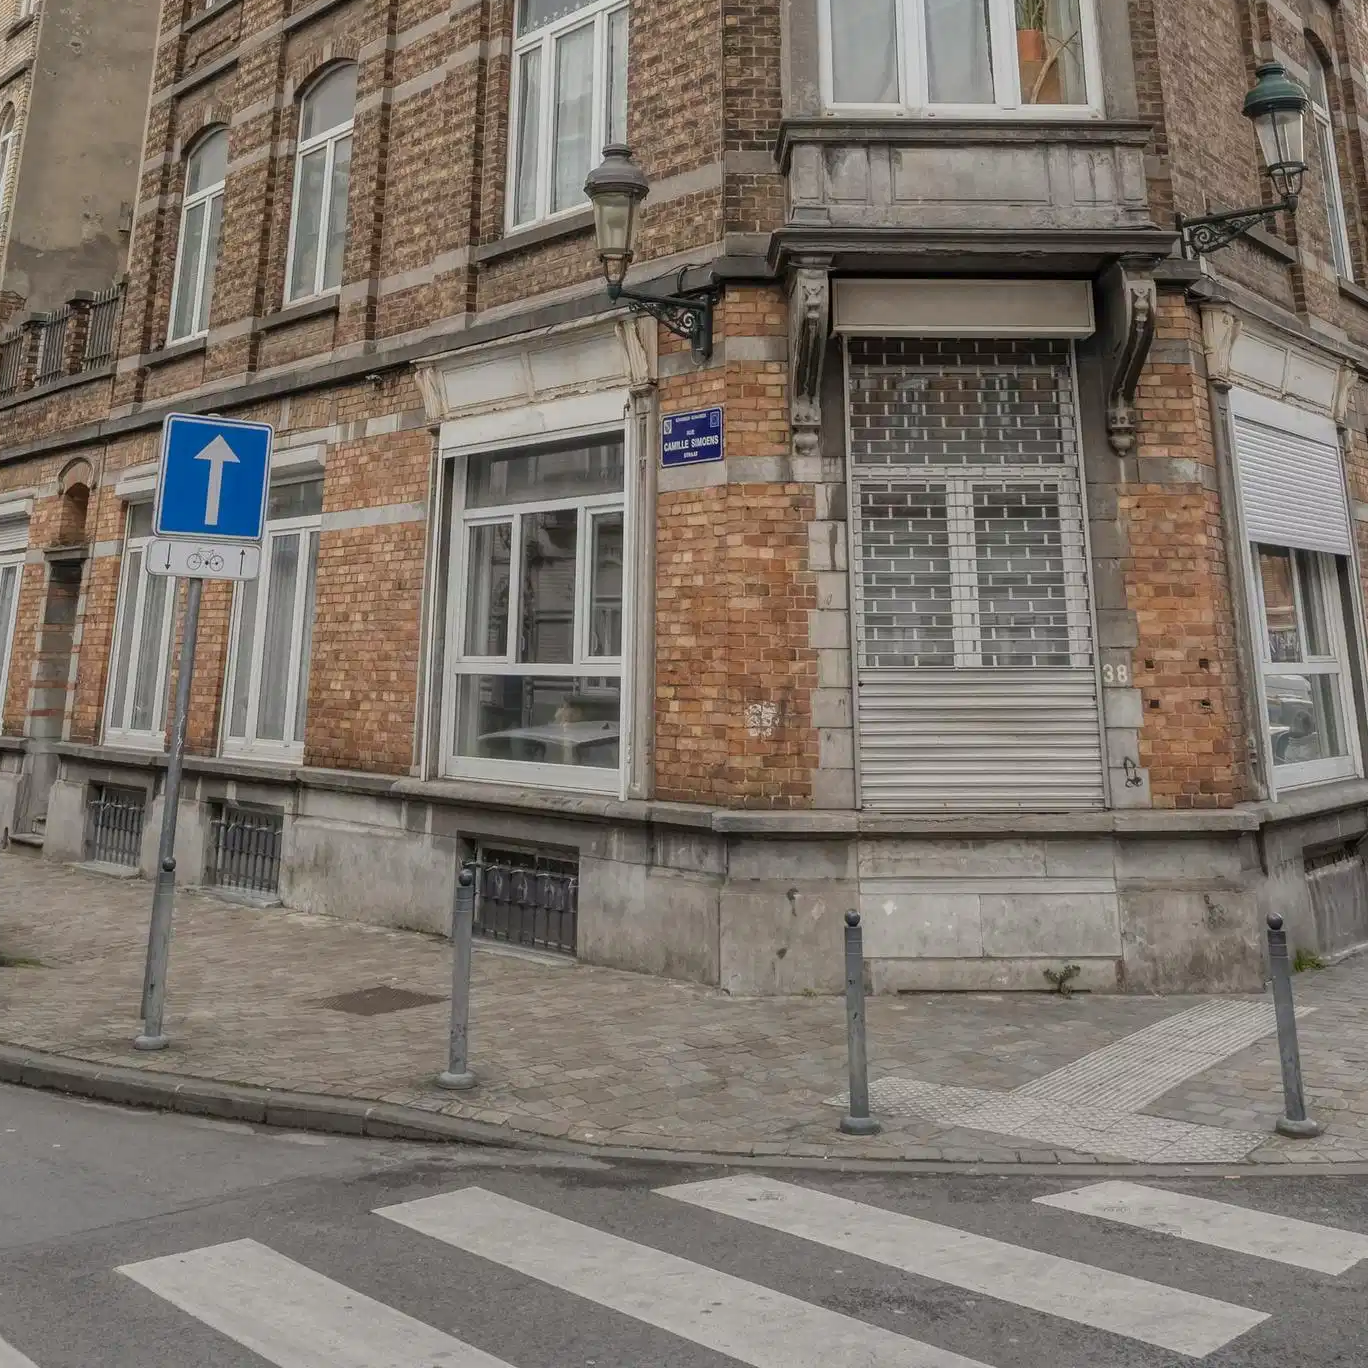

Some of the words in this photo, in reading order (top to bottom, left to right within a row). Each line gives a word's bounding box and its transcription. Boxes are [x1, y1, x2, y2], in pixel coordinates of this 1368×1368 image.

[663, 440, 689, 452] CAMILLE
[691, 435, 719, 448] SIMOENS
[1102, 663, 1128, 683] 38
